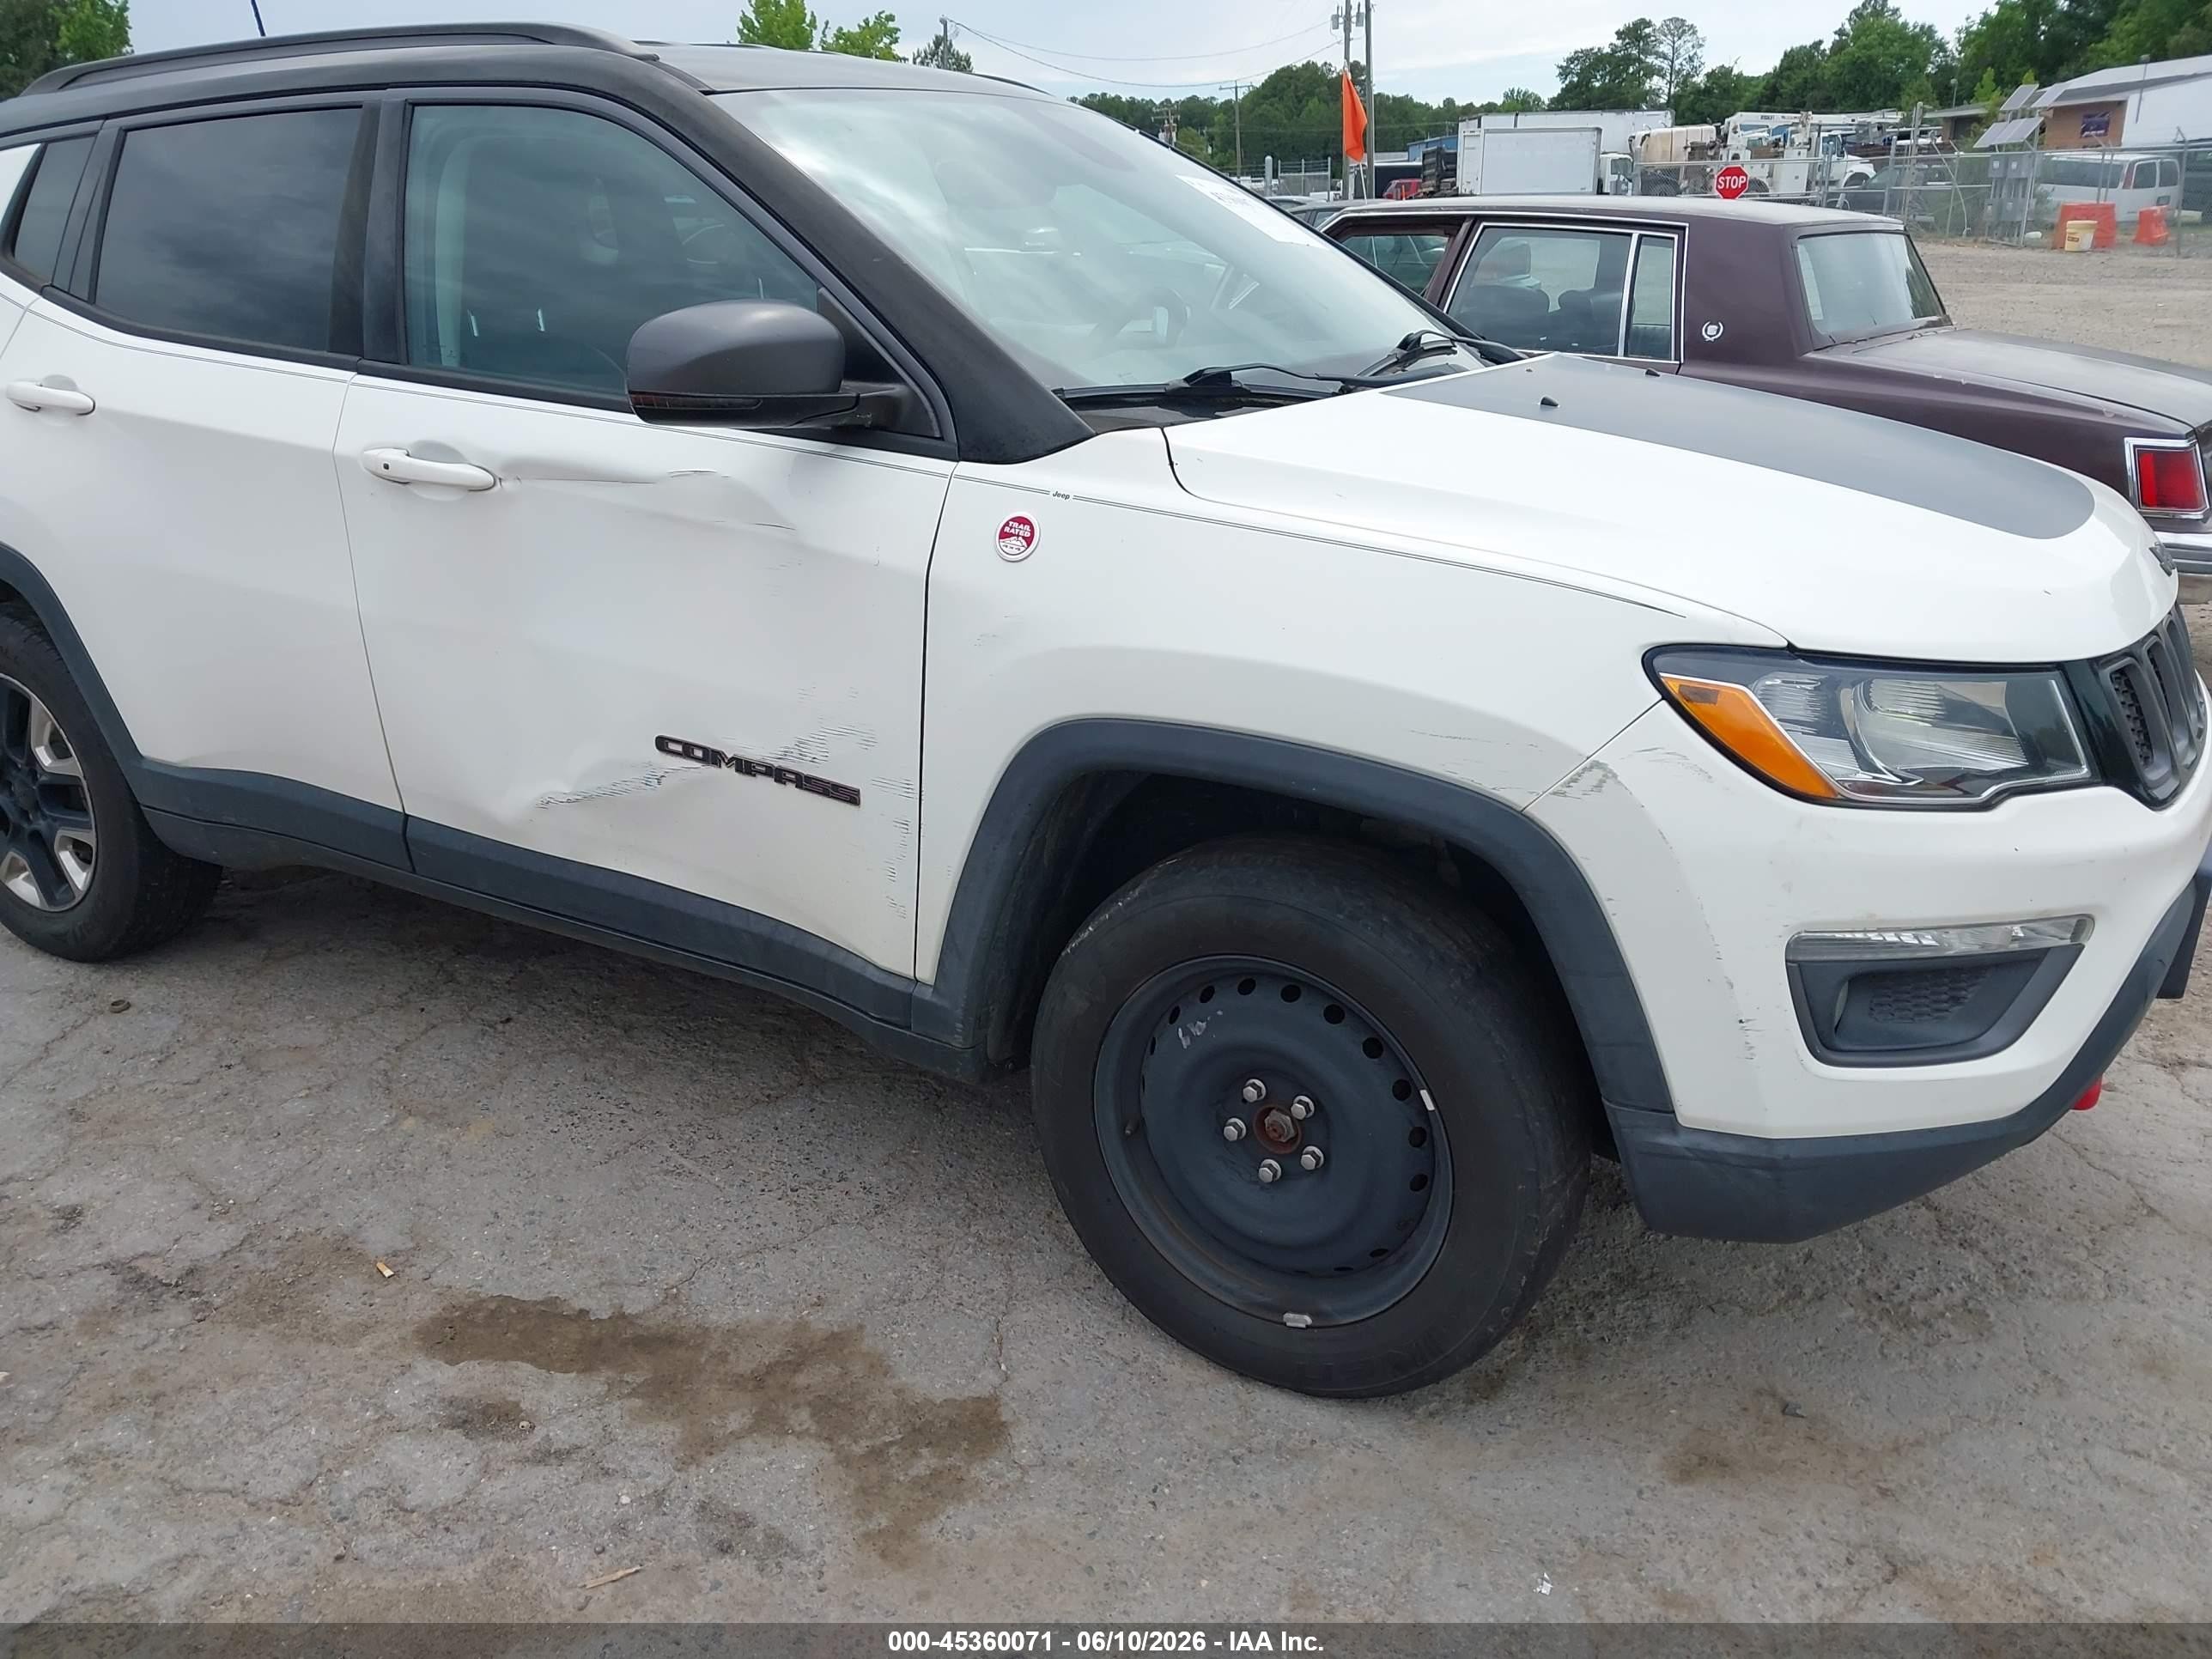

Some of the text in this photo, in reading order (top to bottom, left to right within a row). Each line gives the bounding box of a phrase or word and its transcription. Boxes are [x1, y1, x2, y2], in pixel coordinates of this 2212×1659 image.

[1717, 175, 1747, 189] STOP
[1053, 490, 1071, 501] Jeep
[1004, 526, 1031, 538] RATED
[1008, 520, 1031, 532] TRAIL
[653, 734, 862, 807] COMPASS
